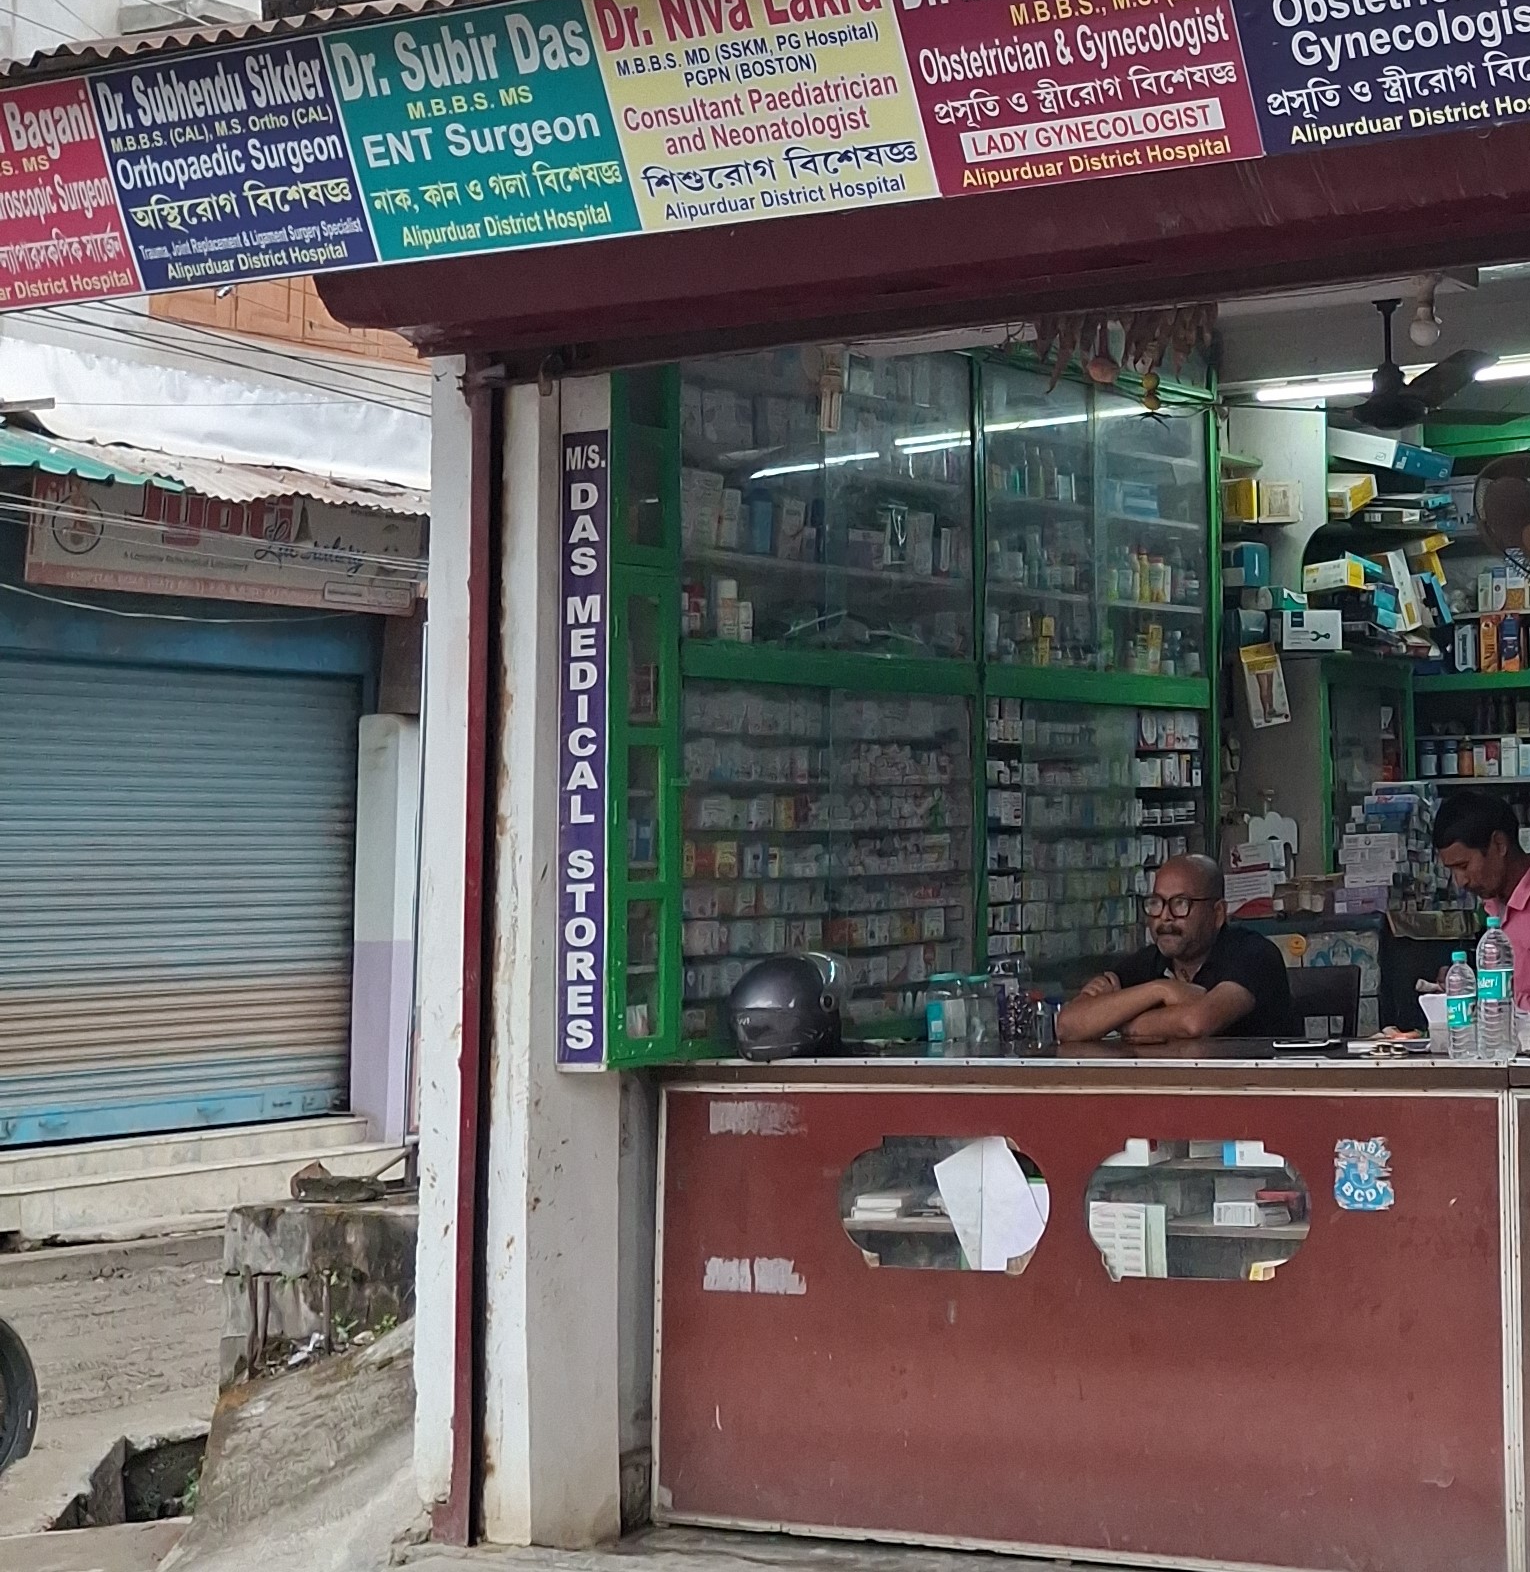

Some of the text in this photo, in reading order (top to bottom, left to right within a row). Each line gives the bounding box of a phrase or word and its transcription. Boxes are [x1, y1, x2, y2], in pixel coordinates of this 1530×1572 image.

[330, 13, 592, 101] Dr. Subir Das
[616, 21, 879, 77] M.B.B.S. MD (SSKM, PG Hospital)
[684, 53, 818, 88] PGPN (BOSTON)
[96, 50, 325, 131] Dr. Subhendu Sikder
[1266, 77, 1342, 120] প্রসূতি
[1349, 80, 1371, 104] ও
[1377, 62, 1477, 103] স্ত্রীরোগ
[3, 89, 95, 159] Bagani
[110, 105, 333, 153] M.B.B.S. (CAL), M.S. Ortho (CAL)
[363, 111, 600, 168] ENT Surgeon
[971, 105, 1211, 157] LADY GYNECOLOGIST
[116, 133, 343, 191] Orthopaedic Surgeon
[370, 161, 622, 215] নাক, কান ও গলা বিশেষজ্ঞ
[641, 141, 917, 198] শিশুরোগ বিশেষজ্ঞ
[54, 174, 114, 219] Surgeon
[129, 178, 352, 233] অস্থিরোগ বিশেষজ্ঞ
[242, 232, 250, 247] &
[289, 225, 321, 242] Surgery
[321, 218, 363, 236] Specialist
[568, 481, 599, 577] DAS
[566, 594, 601, 826] MEDICAL
[565, 850, 597, 1050] STORES
